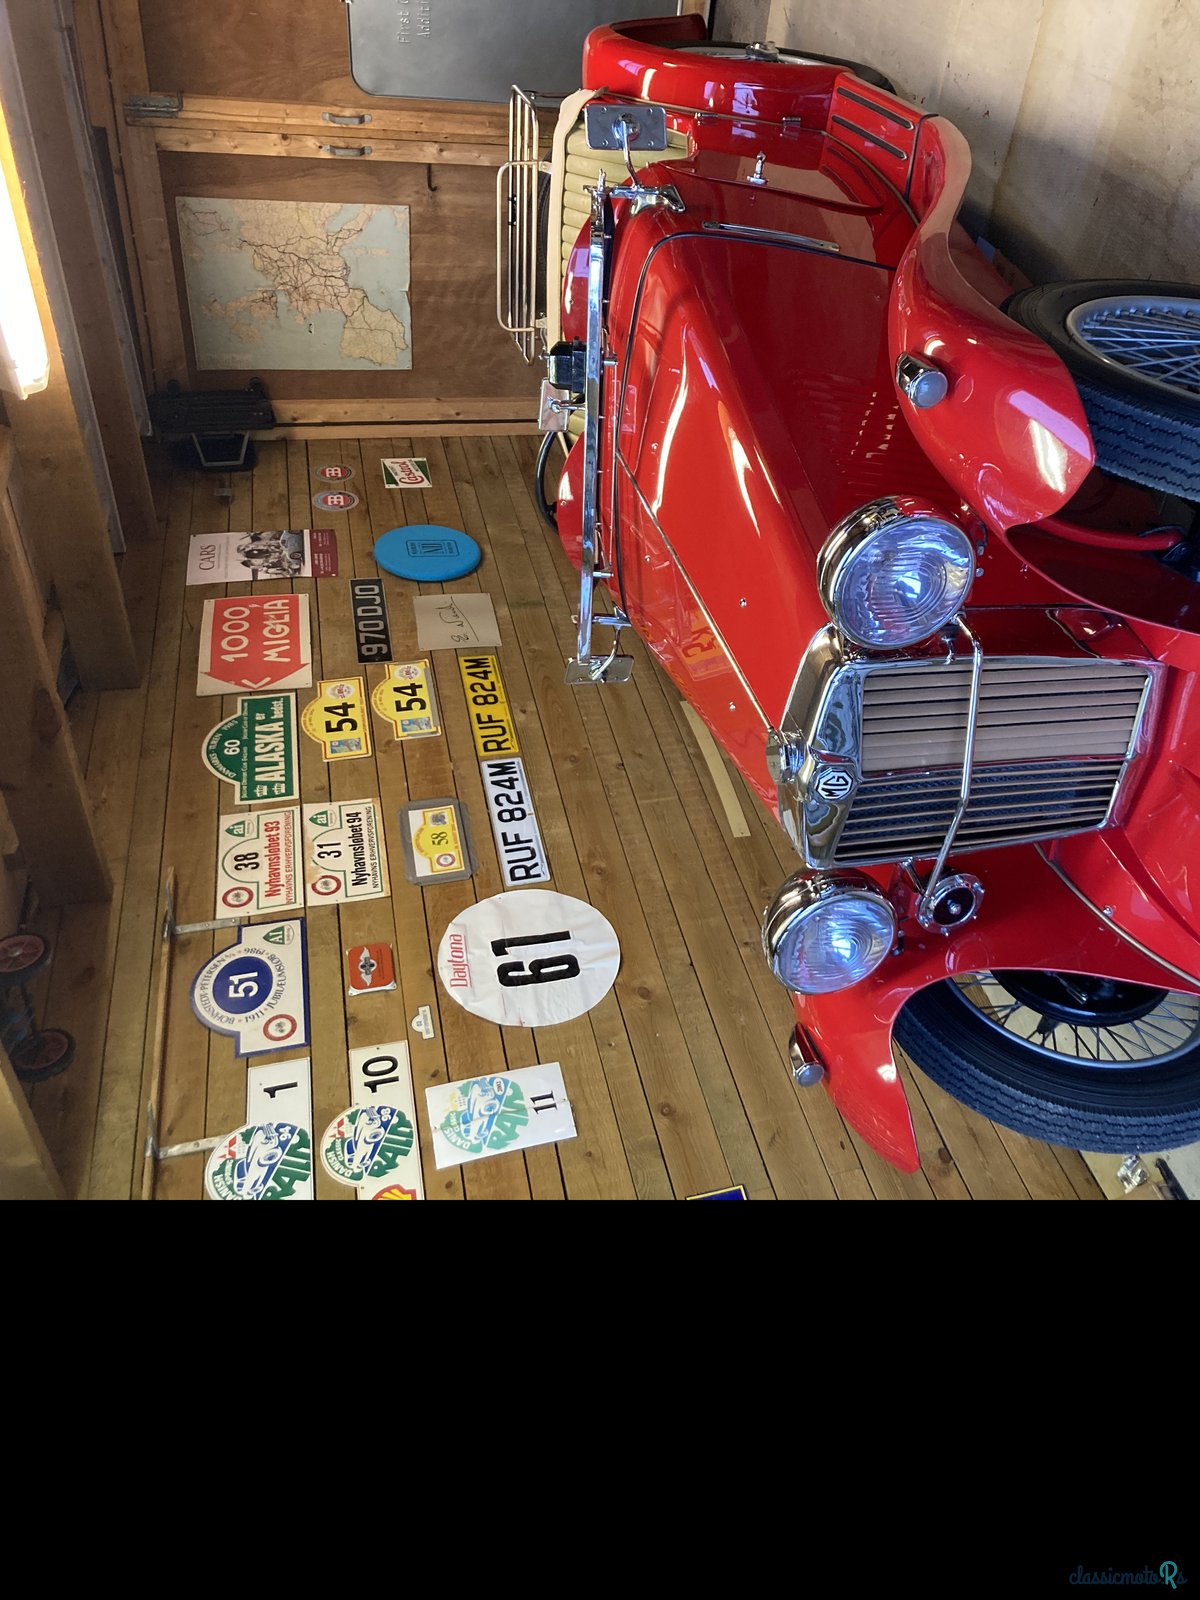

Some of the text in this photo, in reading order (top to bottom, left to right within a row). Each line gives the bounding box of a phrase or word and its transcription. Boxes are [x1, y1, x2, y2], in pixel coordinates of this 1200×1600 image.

[390, 461, 424, 484] Castrol
[198, 544, 216, 571] CARS
[354, 584, 383, 616] DJO
[220, 606, 250, 662] 1000
[262, 599, 291, 662] MIGLIA
[358, 620, 388, 656] 970
[392, 682, 426, 712] 54
[463, 656, 512, 752] RUF 824M
[324, 702, 358, 733] 54
[224, 740, 240, 755] 60
[254, 721, 286, 782] ALASKA
[820, 776, 848, 797] MG
[486, 760, 542, 882] RUF 824M
[316, 842, 342, 858] 31
[346, 812, 370, 886] Nyhavnsløbet 94
[366, 806, 380, 888] NYHAVNS ERHVERVSFORENING
[430, 831, 449, 846] 58
[233, 852, 260, 871] 38
[264, 820, 285, 898] Nyhavnsløbet 93
[284, 810, 294, 904] NYHAVNS ERHVERVSFORENING
[446, 934, 470, 987] Daytona
[490, 930, 581, 987] 61
[228, 971, 259, 998] 51
[263, 1082, 298, 1098] 1
[362, 1056, 400, 1094] 10
[380, 1108, 392, 1122] 98
[529, 1090, 558, 1114] 11
[279, 1126, 292, 1141] 94
[326, 1150, 354, 1177] DANISH
